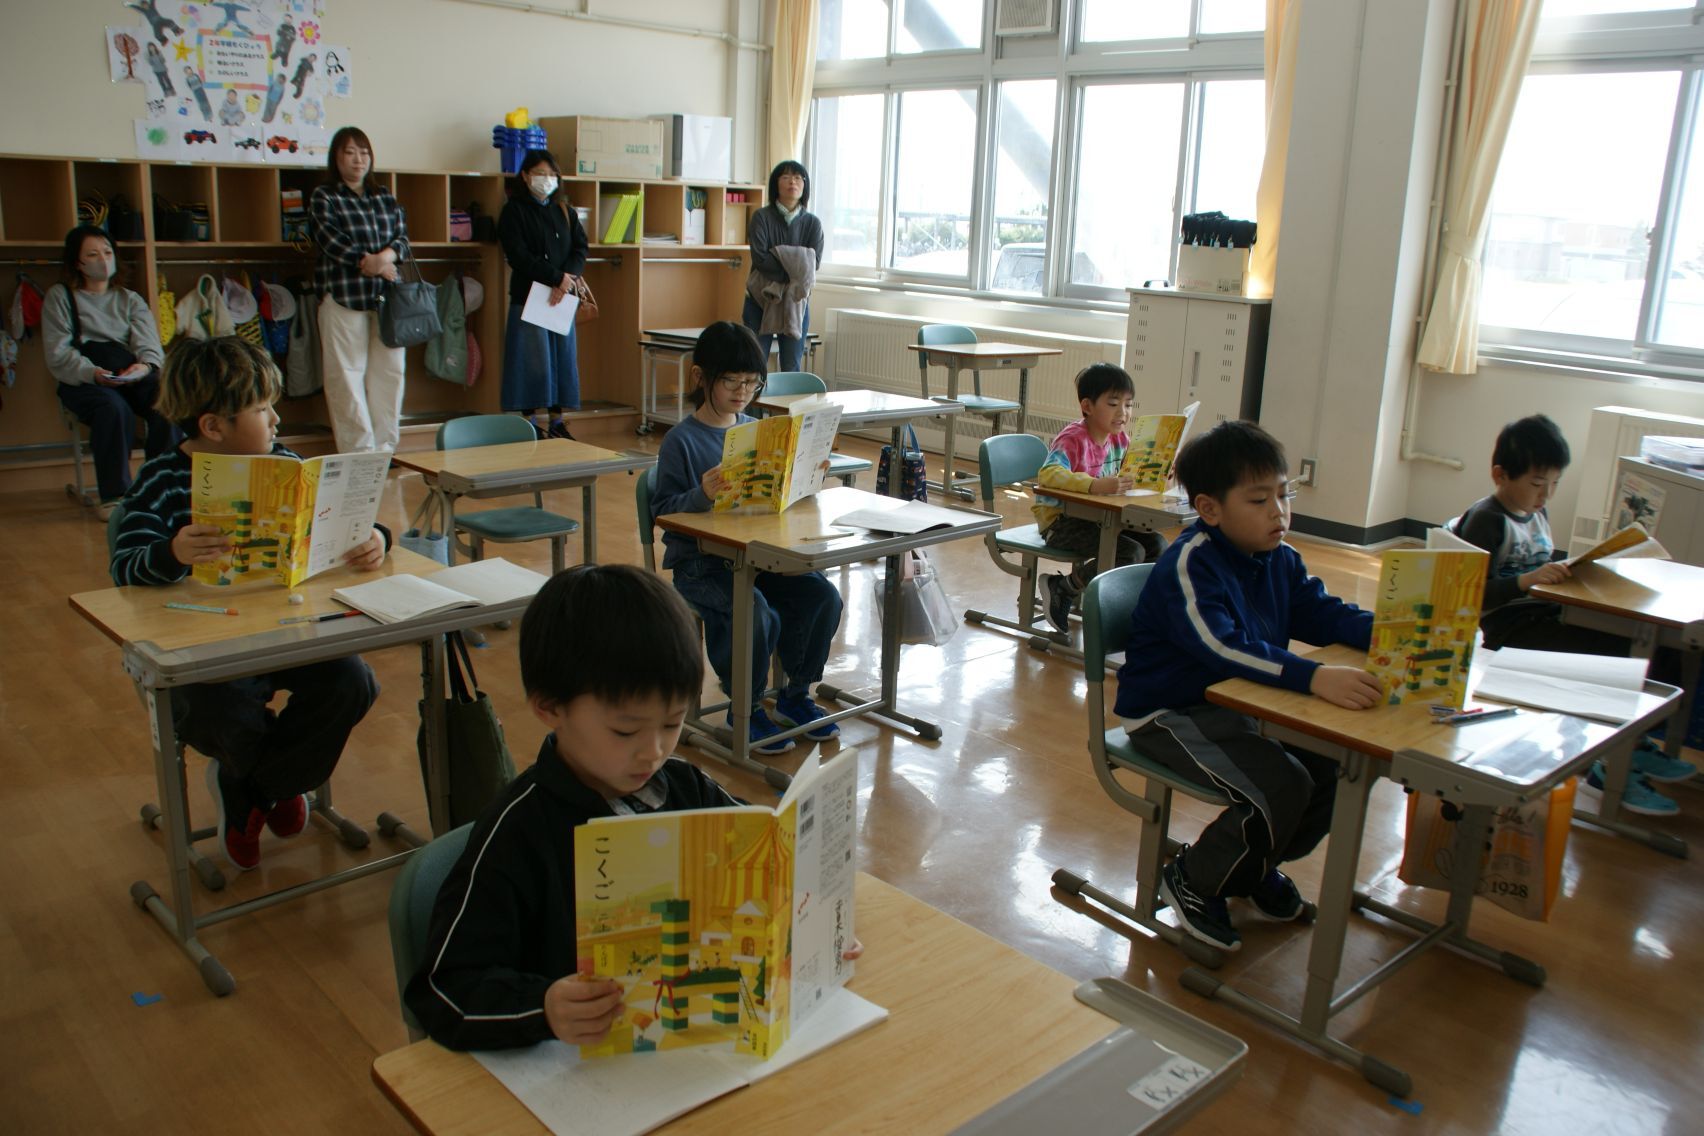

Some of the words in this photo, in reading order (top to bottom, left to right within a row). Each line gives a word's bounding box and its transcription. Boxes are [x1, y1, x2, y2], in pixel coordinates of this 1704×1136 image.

[201, 460, 213, 497] こくご
[1386, 559, 1400, 600] こくご
[595, 837, 614, 900] こくご
[1491, 881, 1529, 898] 1928
